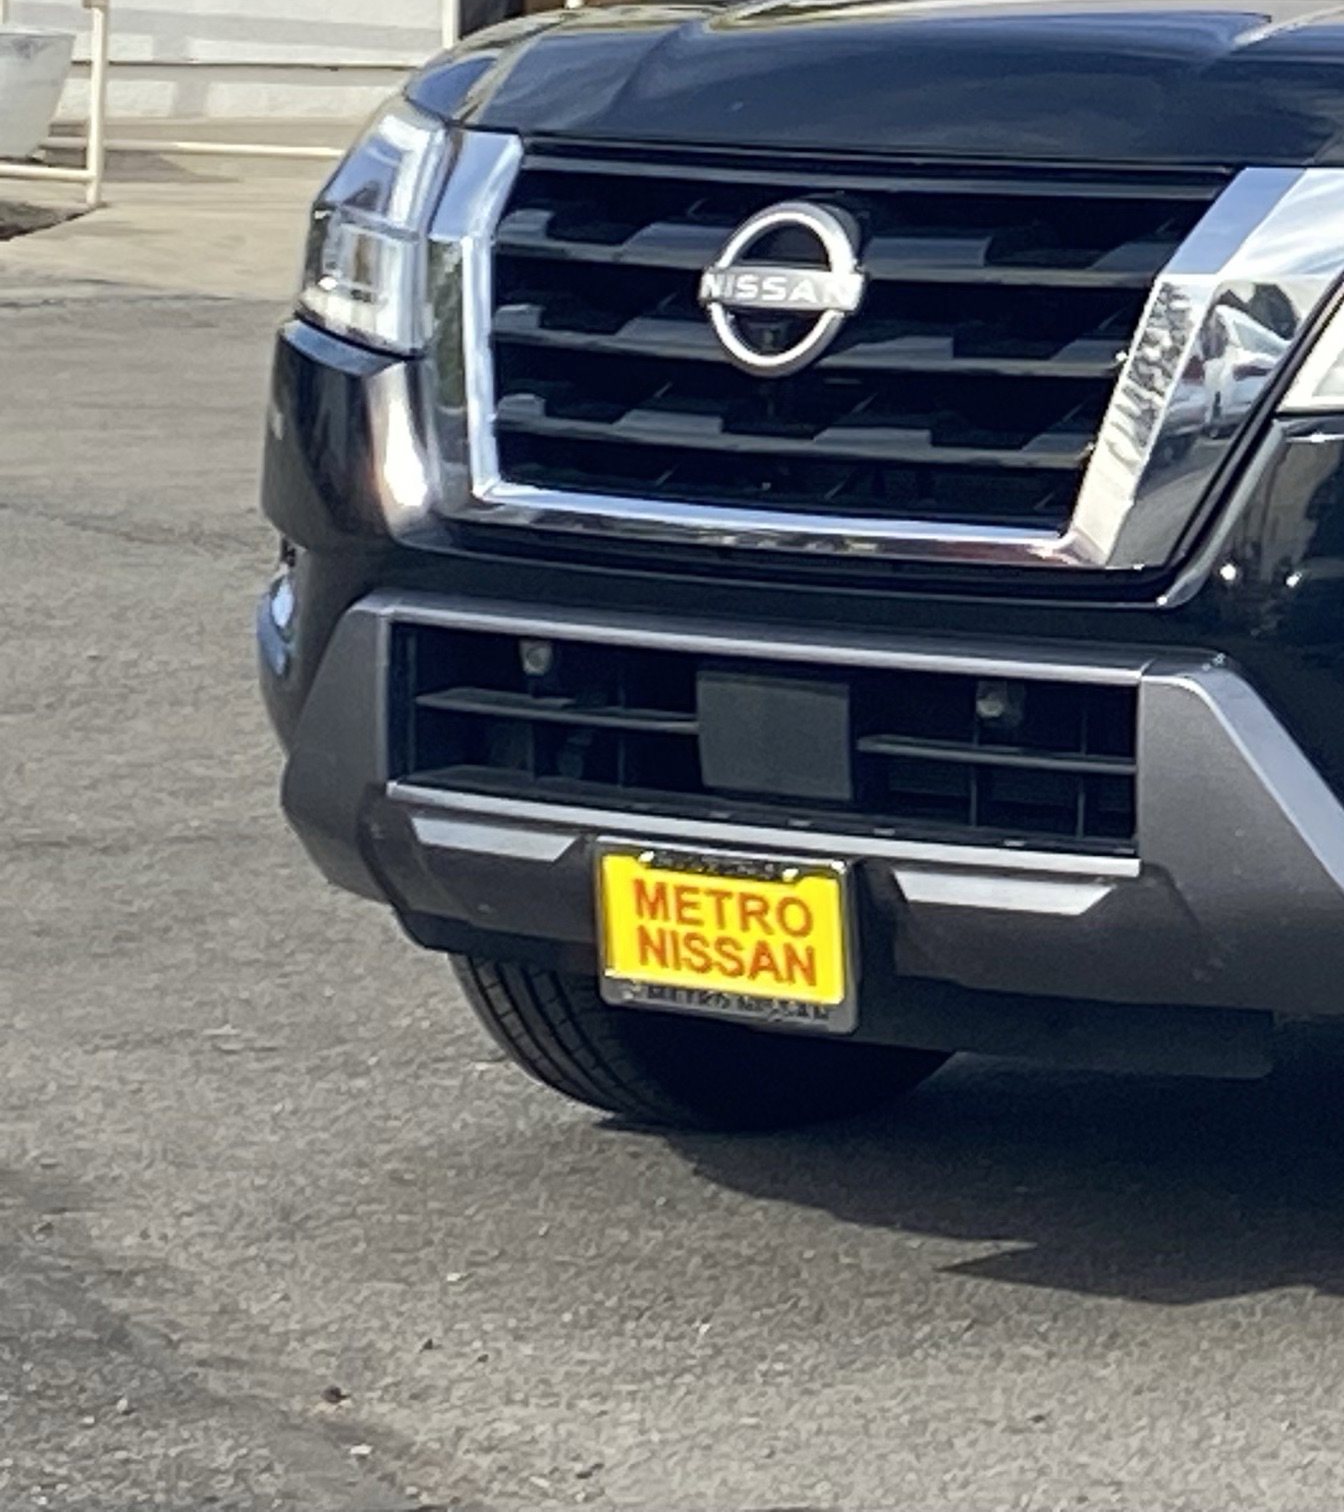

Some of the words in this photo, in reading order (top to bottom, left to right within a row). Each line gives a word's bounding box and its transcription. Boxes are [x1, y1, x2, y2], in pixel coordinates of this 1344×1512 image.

[702, 272, 858, 308] NISSAN
[633, 877, 814, 939] METRO
[637, 924, 818, 987] NISSAN
